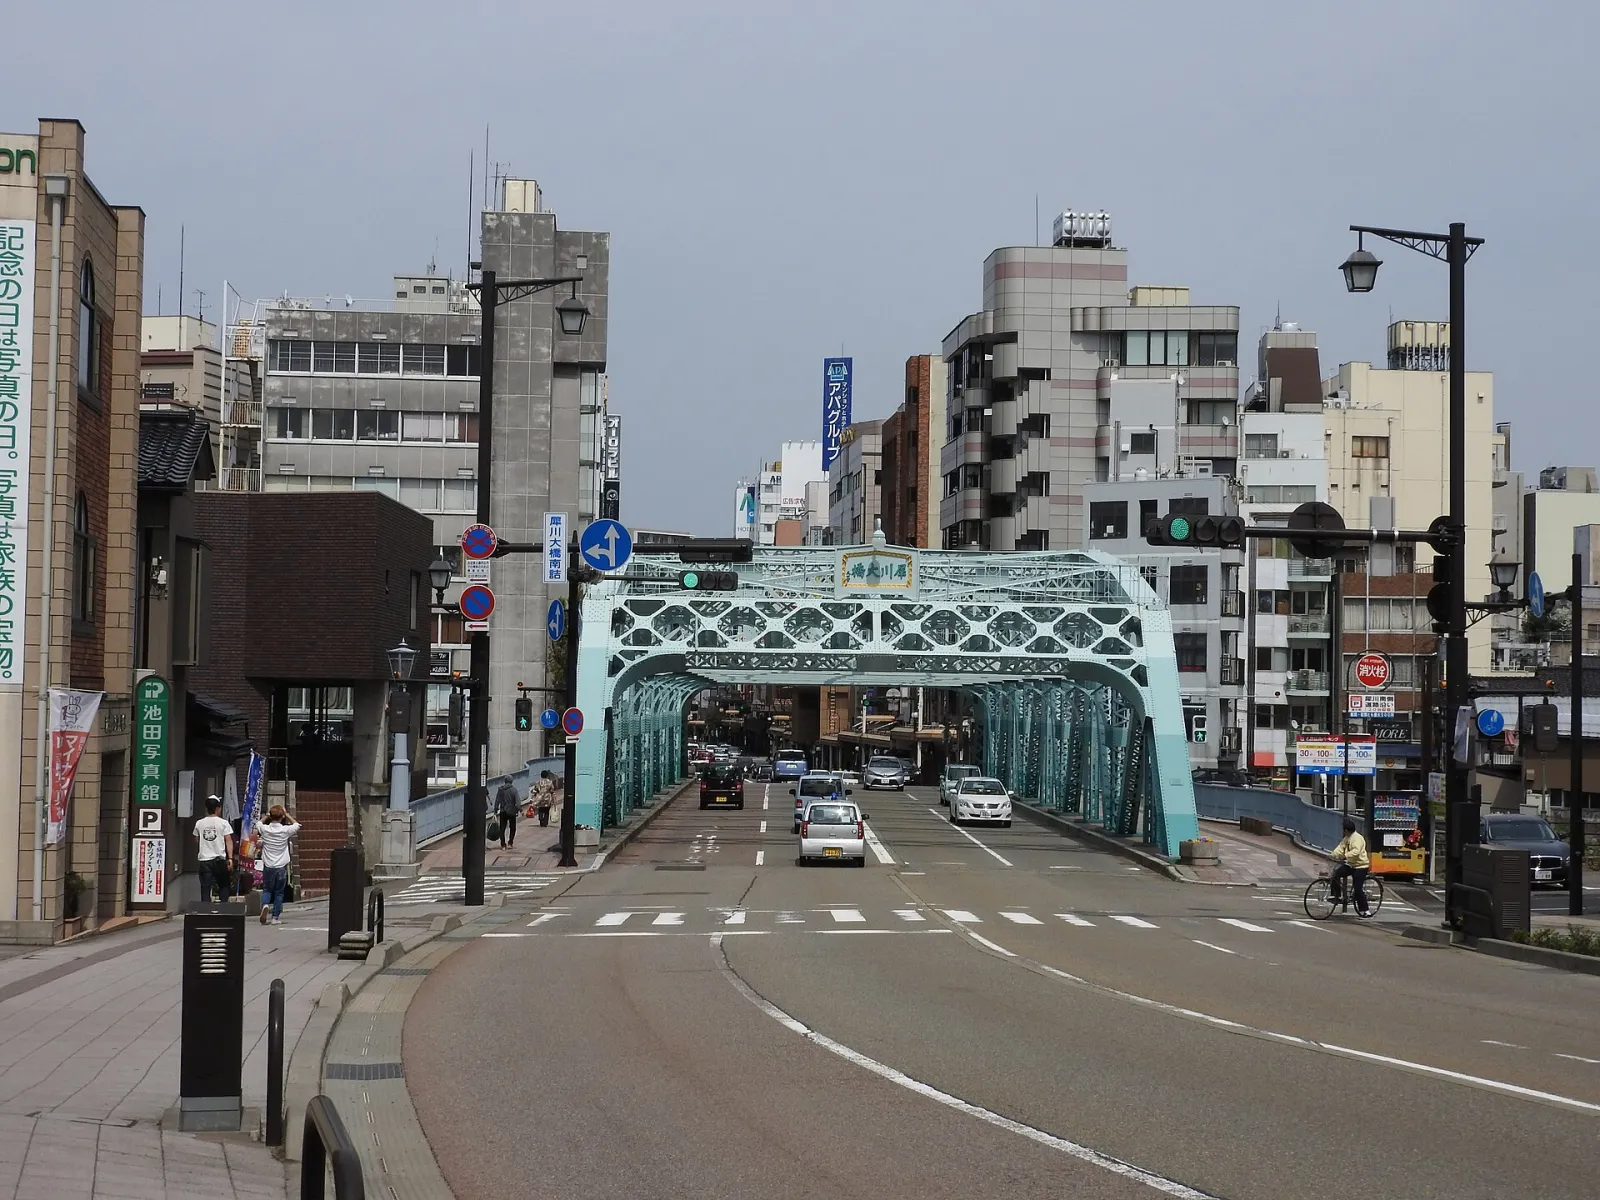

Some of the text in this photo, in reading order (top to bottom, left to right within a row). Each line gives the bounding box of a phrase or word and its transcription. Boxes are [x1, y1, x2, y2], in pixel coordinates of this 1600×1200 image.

[827, 383, 841, 460] アパグループ
[608, 417, 620, 478] オーロラビル
[549, 516, 562, 580] 犀川大橋南詰
[1358, 664, 1386, 678] 消火栓
[1373, 728, 1406, 739] MORE
[142, 811, 158, 828] P
